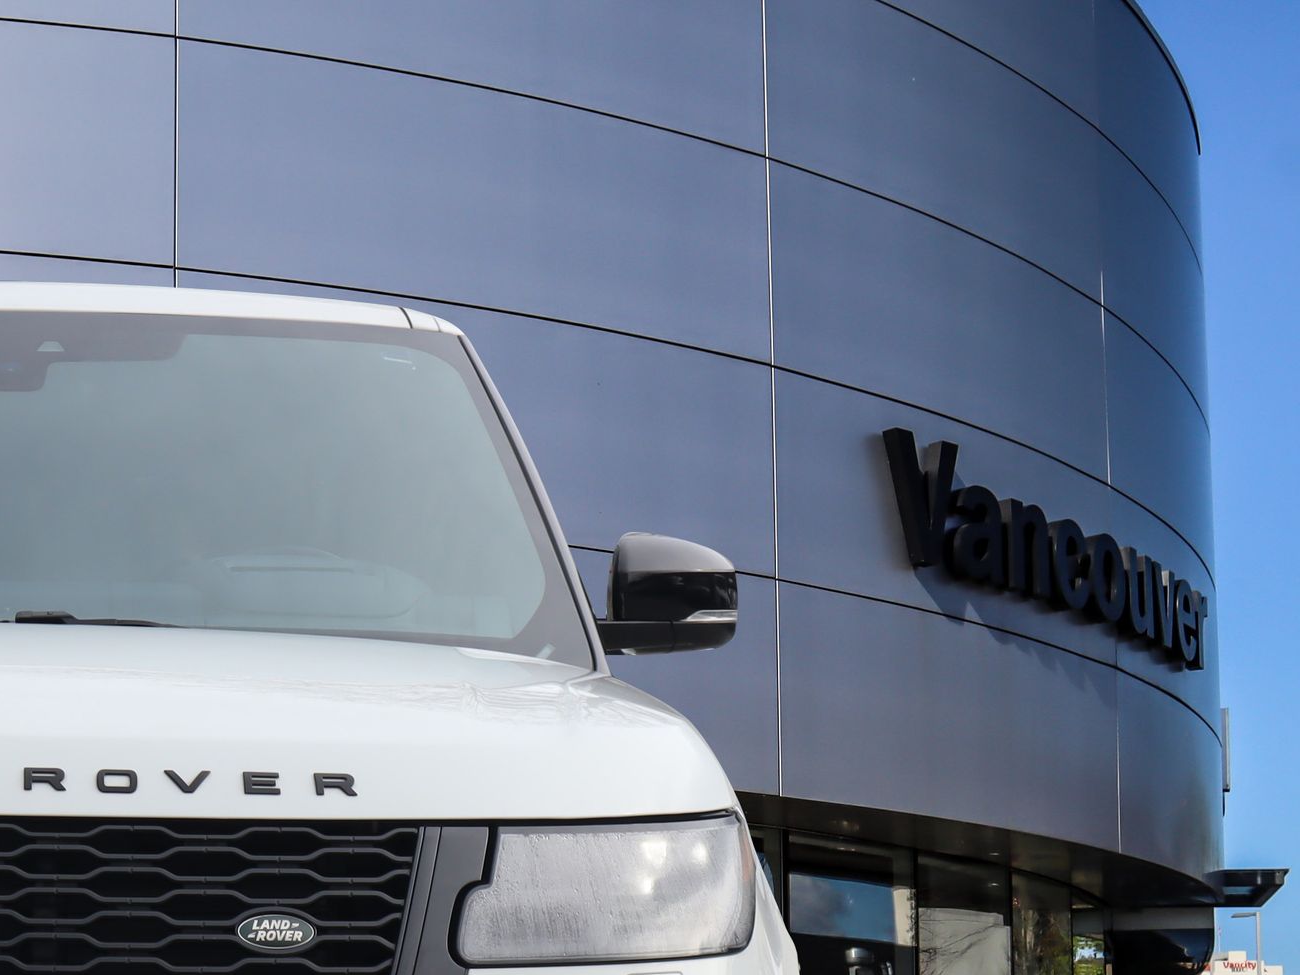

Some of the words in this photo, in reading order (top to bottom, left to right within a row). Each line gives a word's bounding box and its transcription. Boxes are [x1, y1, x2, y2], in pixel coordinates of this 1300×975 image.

[882, 427, 1208, 671] Vancouver
[22, 766, 359, 798] ROVER
[252, 919, 291, 930] LAND
[256, 930, 303, 942] ROVER
